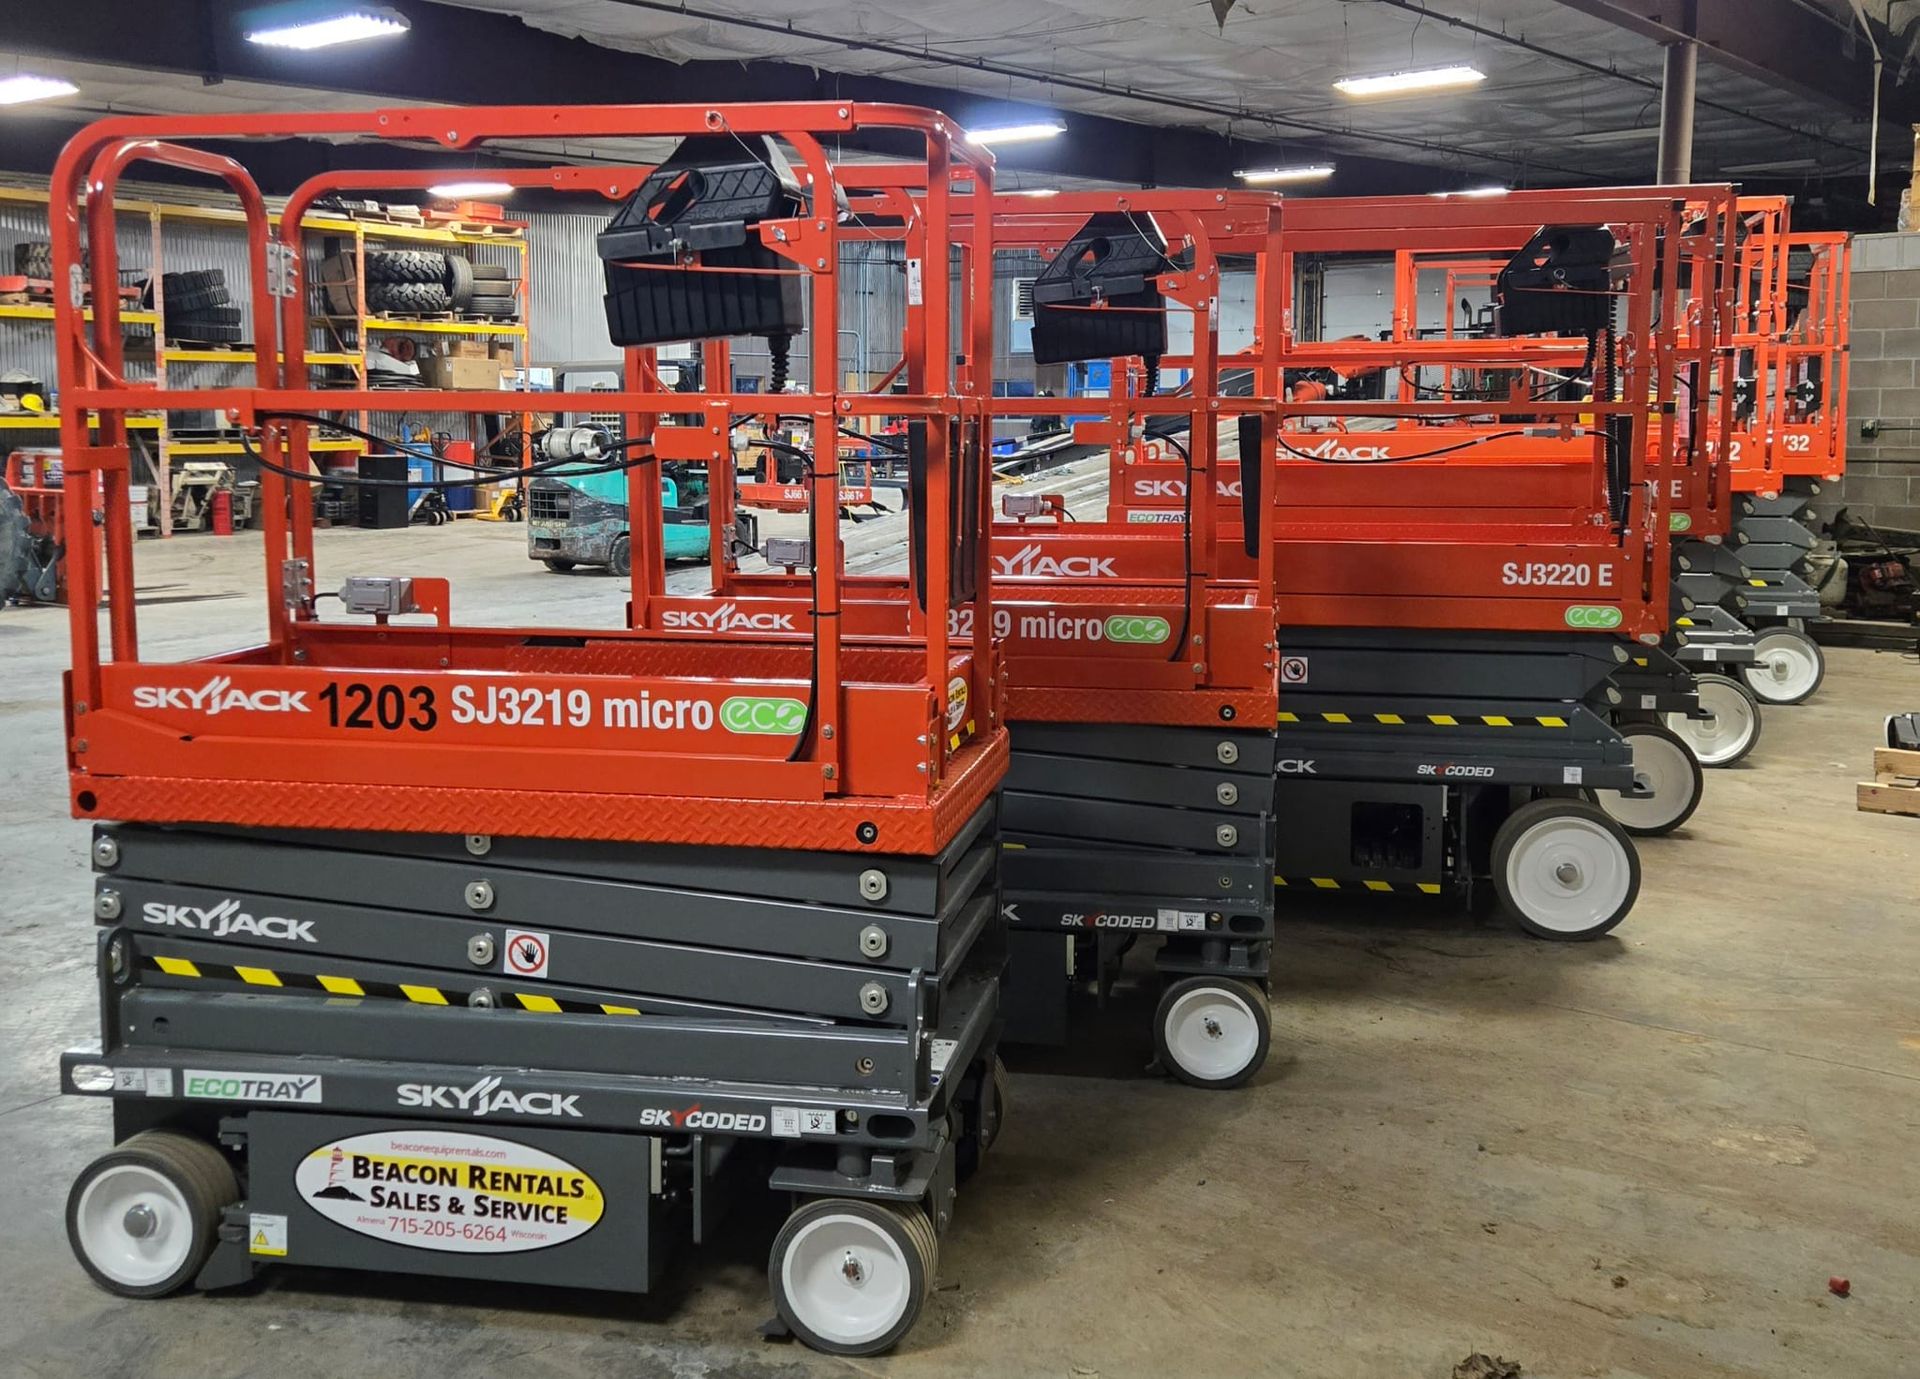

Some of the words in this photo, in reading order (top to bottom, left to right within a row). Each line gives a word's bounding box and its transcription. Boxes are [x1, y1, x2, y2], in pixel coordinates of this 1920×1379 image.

[991, 544, 1118, 577] YJACK
[1502, 562, 1591, 587] SJ3220
[1598, 563, 1613, 587] E
[662, 602, 795, 632] SKYJACK
[1020, 611, 1103, 640] micro
[1108, 617, 1166, 640] eco
[1568, 608, 1617, 625] eco
[132, 676, 312, 715] SKYJACK
[319, 682, 438, 731] 1203
[451, 685, 592, 728] SJ3219
[603, 690, 714, 732] micro
[725, 701, 807, 730] eco
[1416, 760, 1495, 777] SKYCODED
[143, 899, 318, 943] SKYJACK
[1060, 912, 1155, 929] SKYCODED
[188, 1077, 318, 1099] ECOTRAY
[397, 1075, 583, 1118] SKYJACK
[639, 1104, 767, 1132] SKYCODED
[391, 1141, 507, 1159] beaconequiprentals.com
[352, 1156, 458, 1188] BEACON
[468, 1165, 584, 1199] RENTALS
[370, 1186, 442, 1214] SALES
[447, 1196, 465, 1216] &
[473, 1195, 568, 1225] SERVICE
[388, 1216, 506, 1242] 715-205-6264
[511, 1229, 548, 1241] Wisconsin
